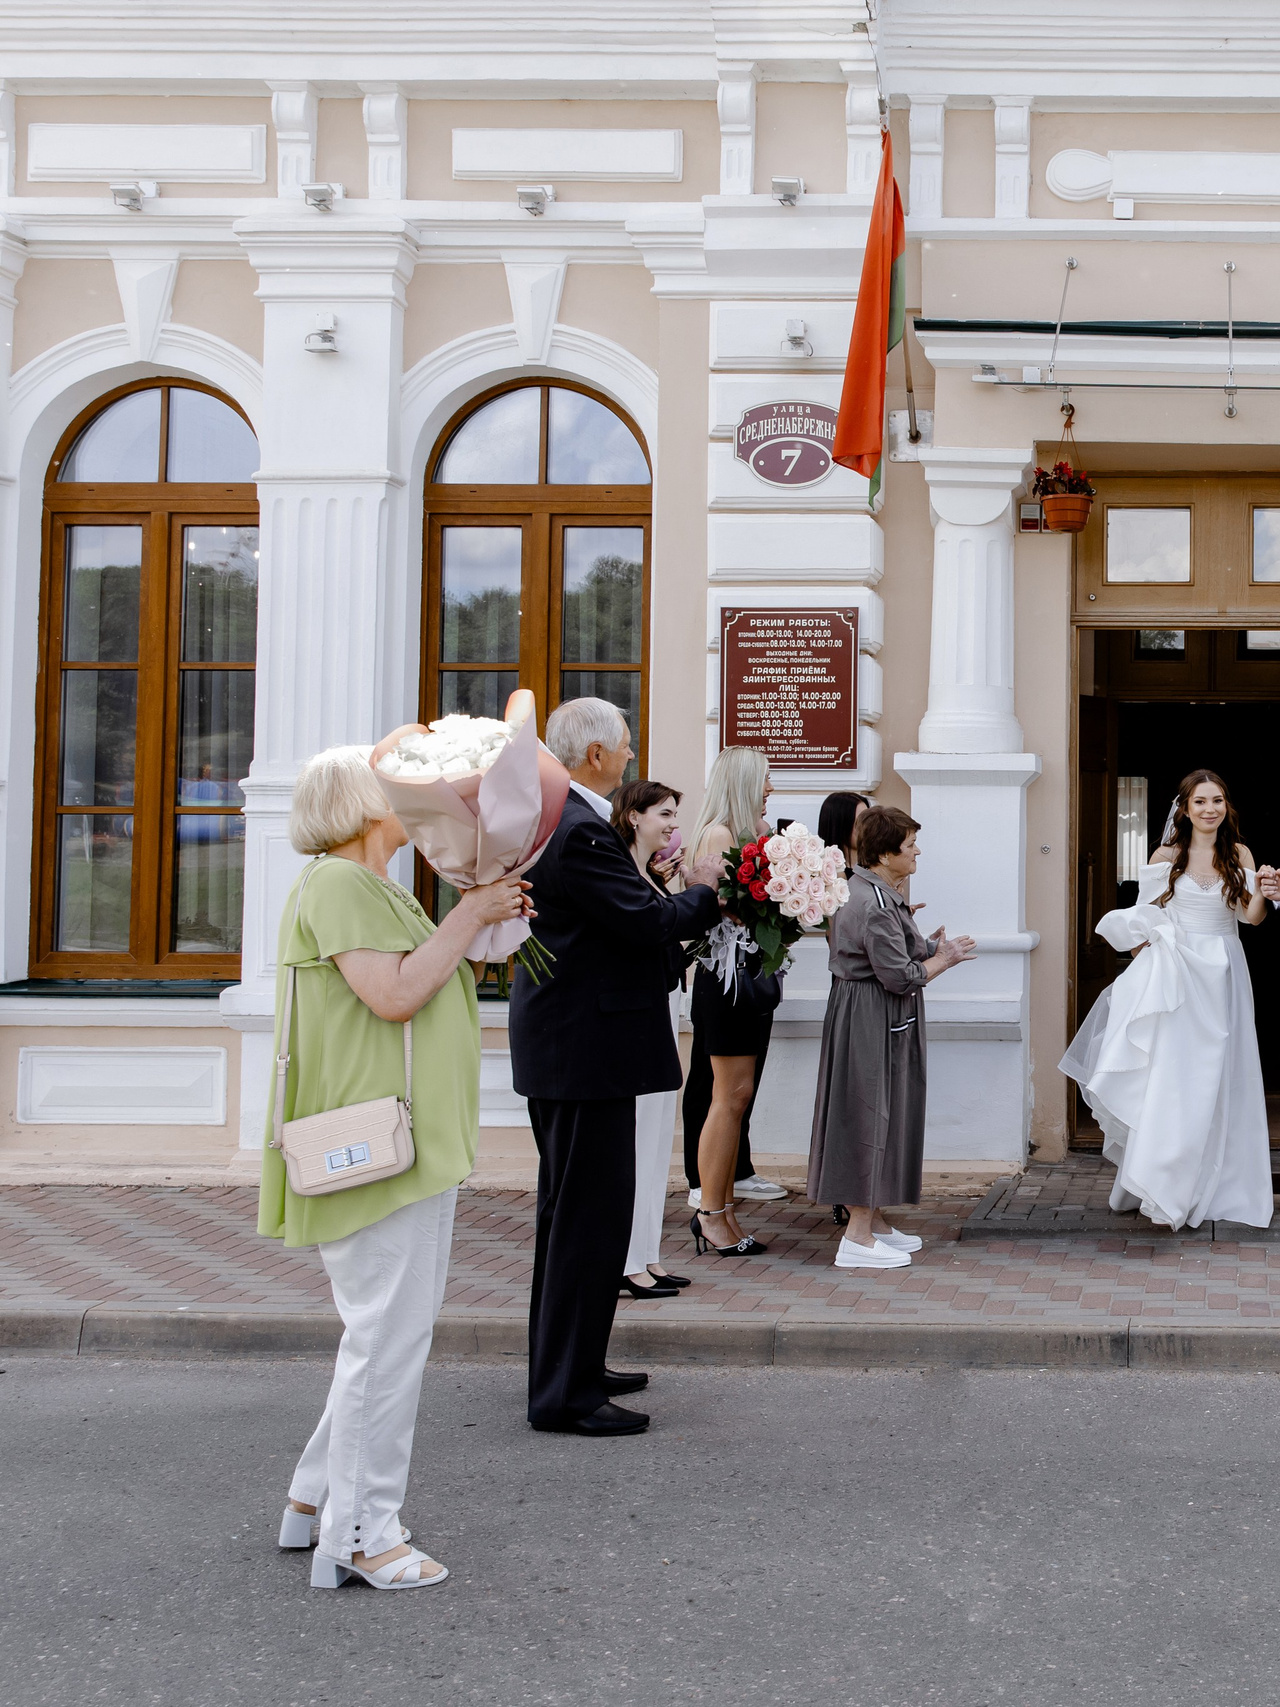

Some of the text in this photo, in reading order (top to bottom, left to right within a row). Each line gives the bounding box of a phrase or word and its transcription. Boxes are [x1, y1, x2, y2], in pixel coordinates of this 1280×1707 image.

[773, 405, 811, 416] улица
[739, 417, 837, 445] СРЕДНЕНАБЕРЕЖНА
[781, 449, 802, 476] 7
[750, 619, 831, 627] РЕЖИМ РАБОТЫ:
[796, 629, 832, 638] 14.00-20.00
[809, 639, 843, 648] 14.00-17.00
[752, 666, 827, 675] ГРАФИК ПРИЁМА
[742, 675, 836, 683] ЗАИНТЕРЕСОВАННЫХ
[778, 684, 800, 692] ЛИЦ:
[761, 692, 800, 701] 11.00-13.00;
[801, 692, 841, 700] 14.00-20.00
[755, 701, 797, 710] 08.00-13.00;
[799, 701, 836, 709] 14.00-17.00
[760, 710, 800, 718] 08.00-13.00
[761, 719, 804, 727] 08.00-09.00
[760, 728, 803, 736] 08.00-09.00
